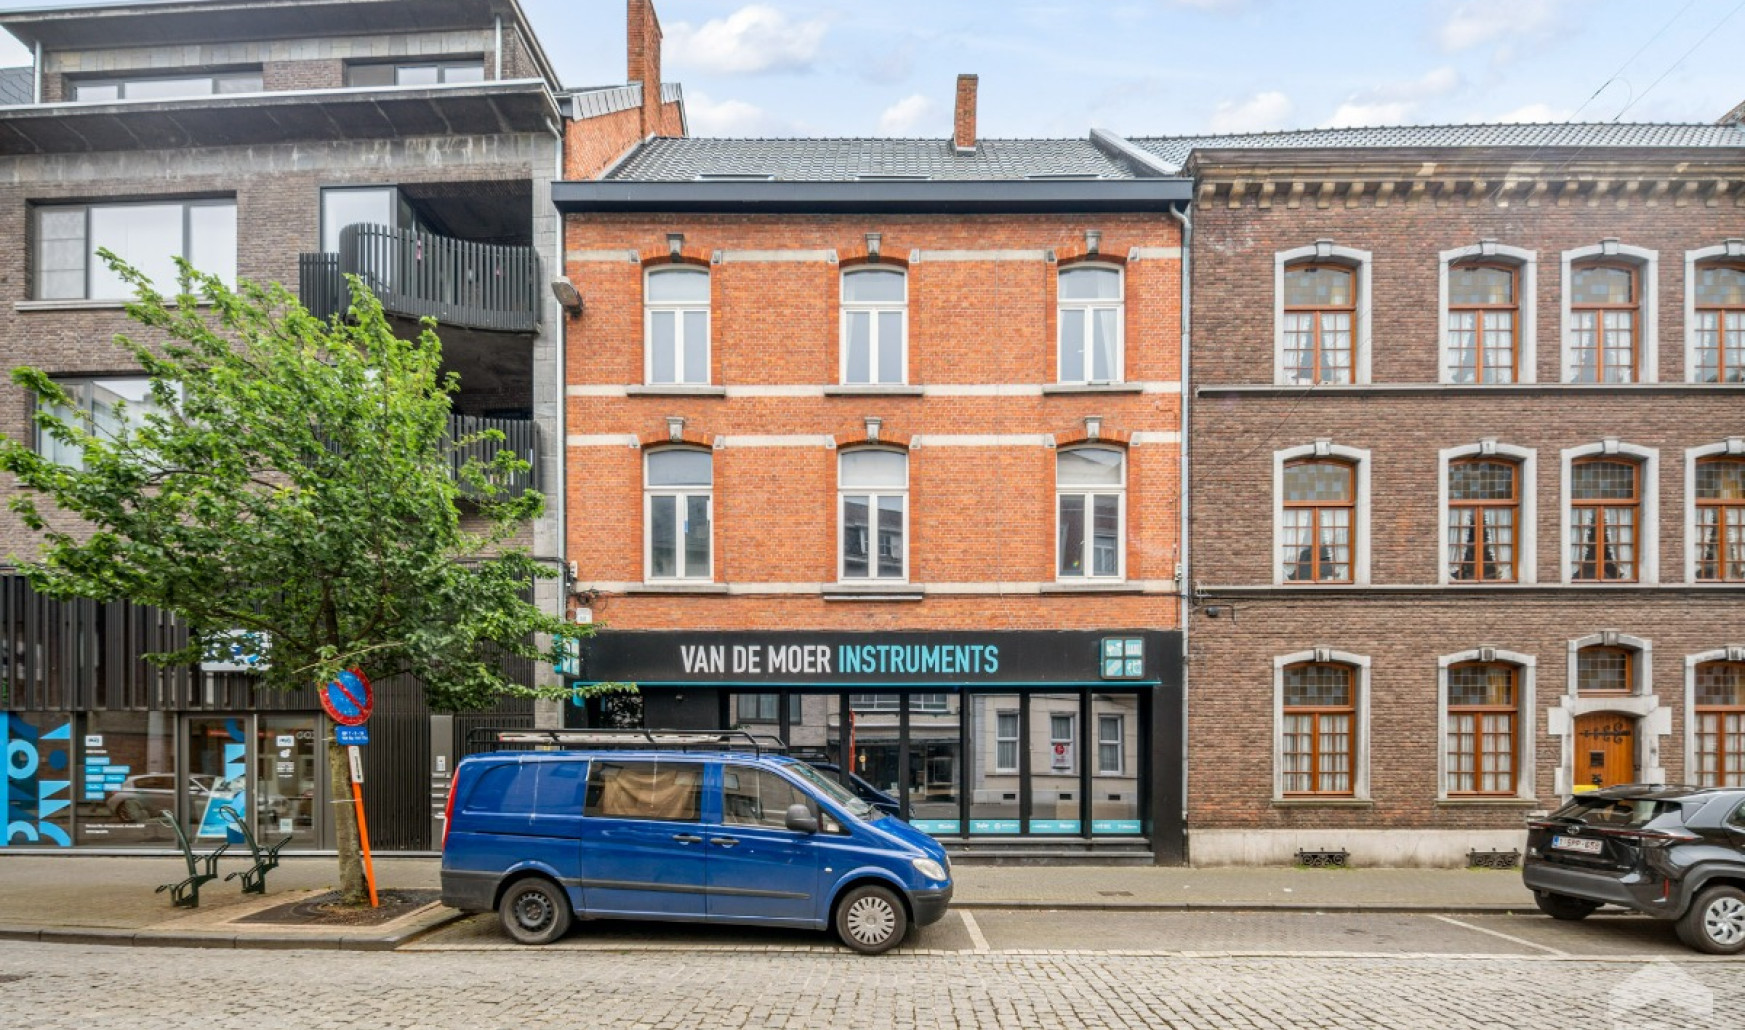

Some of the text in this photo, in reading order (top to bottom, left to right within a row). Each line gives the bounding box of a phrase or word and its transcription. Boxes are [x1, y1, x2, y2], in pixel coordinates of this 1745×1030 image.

[681, 645, 999, 673] VAN DE MOER INSTRUMENTS
